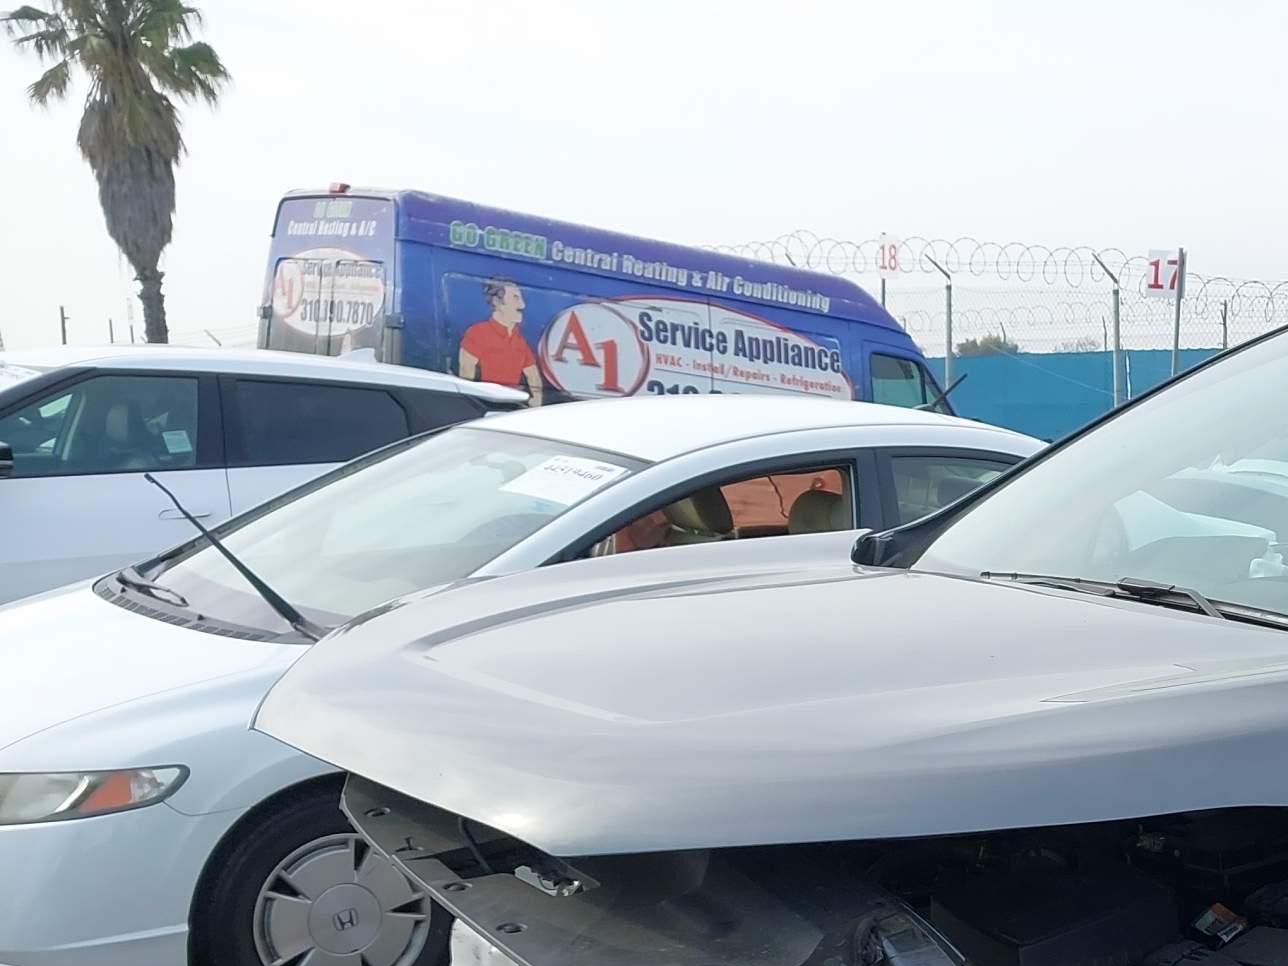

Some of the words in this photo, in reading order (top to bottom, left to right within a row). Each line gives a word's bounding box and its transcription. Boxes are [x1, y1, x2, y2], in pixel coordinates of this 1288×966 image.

[450, 220, 479, 247] GO
[483, 225, 548, 260] GREEN
[551, 240, 618, 272] Central
[622, 254, 688, 286] Heating
[691, 272, 703, 288] &
[706, 270, 730, 292] Air
[732, 275, 830, 313] Conditioning
[879, 243, 897, 271] 18
[1147, 259, 1179, 290] 17
[552, 310, 625, 393] A1
[638, 311, 728, 355] Service
[733, 329, 841, 374] Appliance
[656, 353, 683, 368] HVAC
[693, 359, 770, 382] Install/Repairs
[780, 372, 842, 393] Refrigeration
